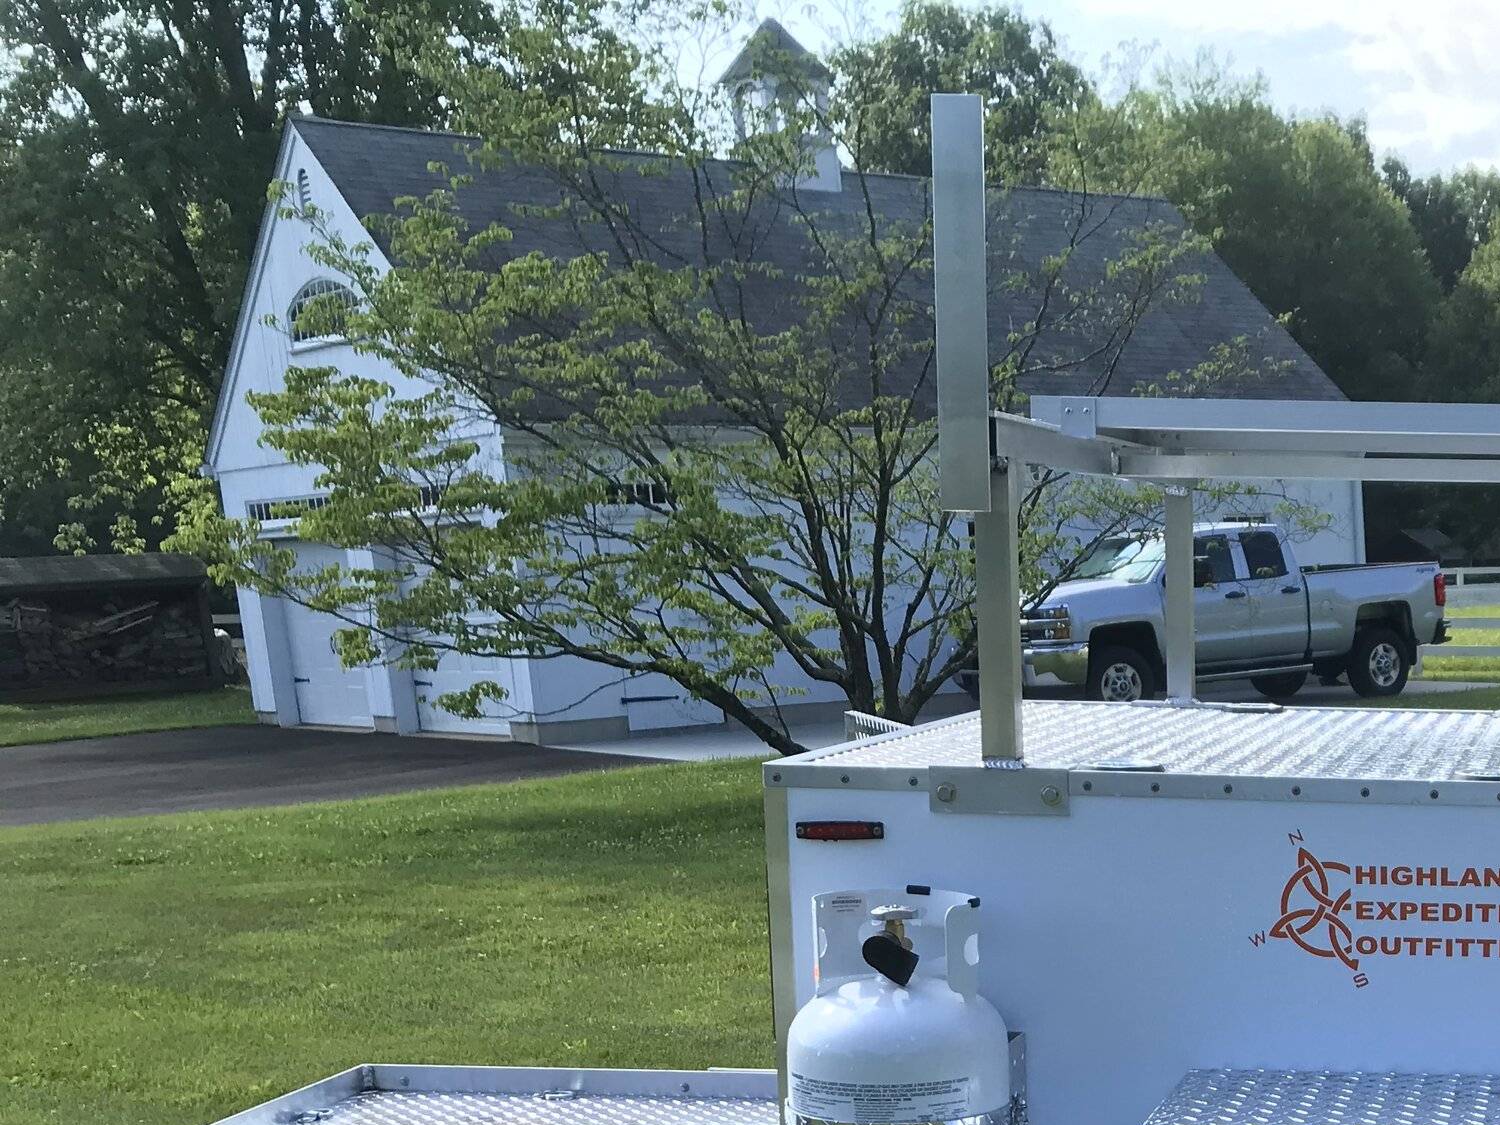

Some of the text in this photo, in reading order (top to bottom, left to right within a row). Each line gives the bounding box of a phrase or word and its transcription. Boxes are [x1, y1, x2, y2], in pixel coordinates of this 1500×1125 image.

[1288, 829, 1304, 846] N
[1248, 930, 1266, 948] W
[1353, 973, 1369, 989] S
